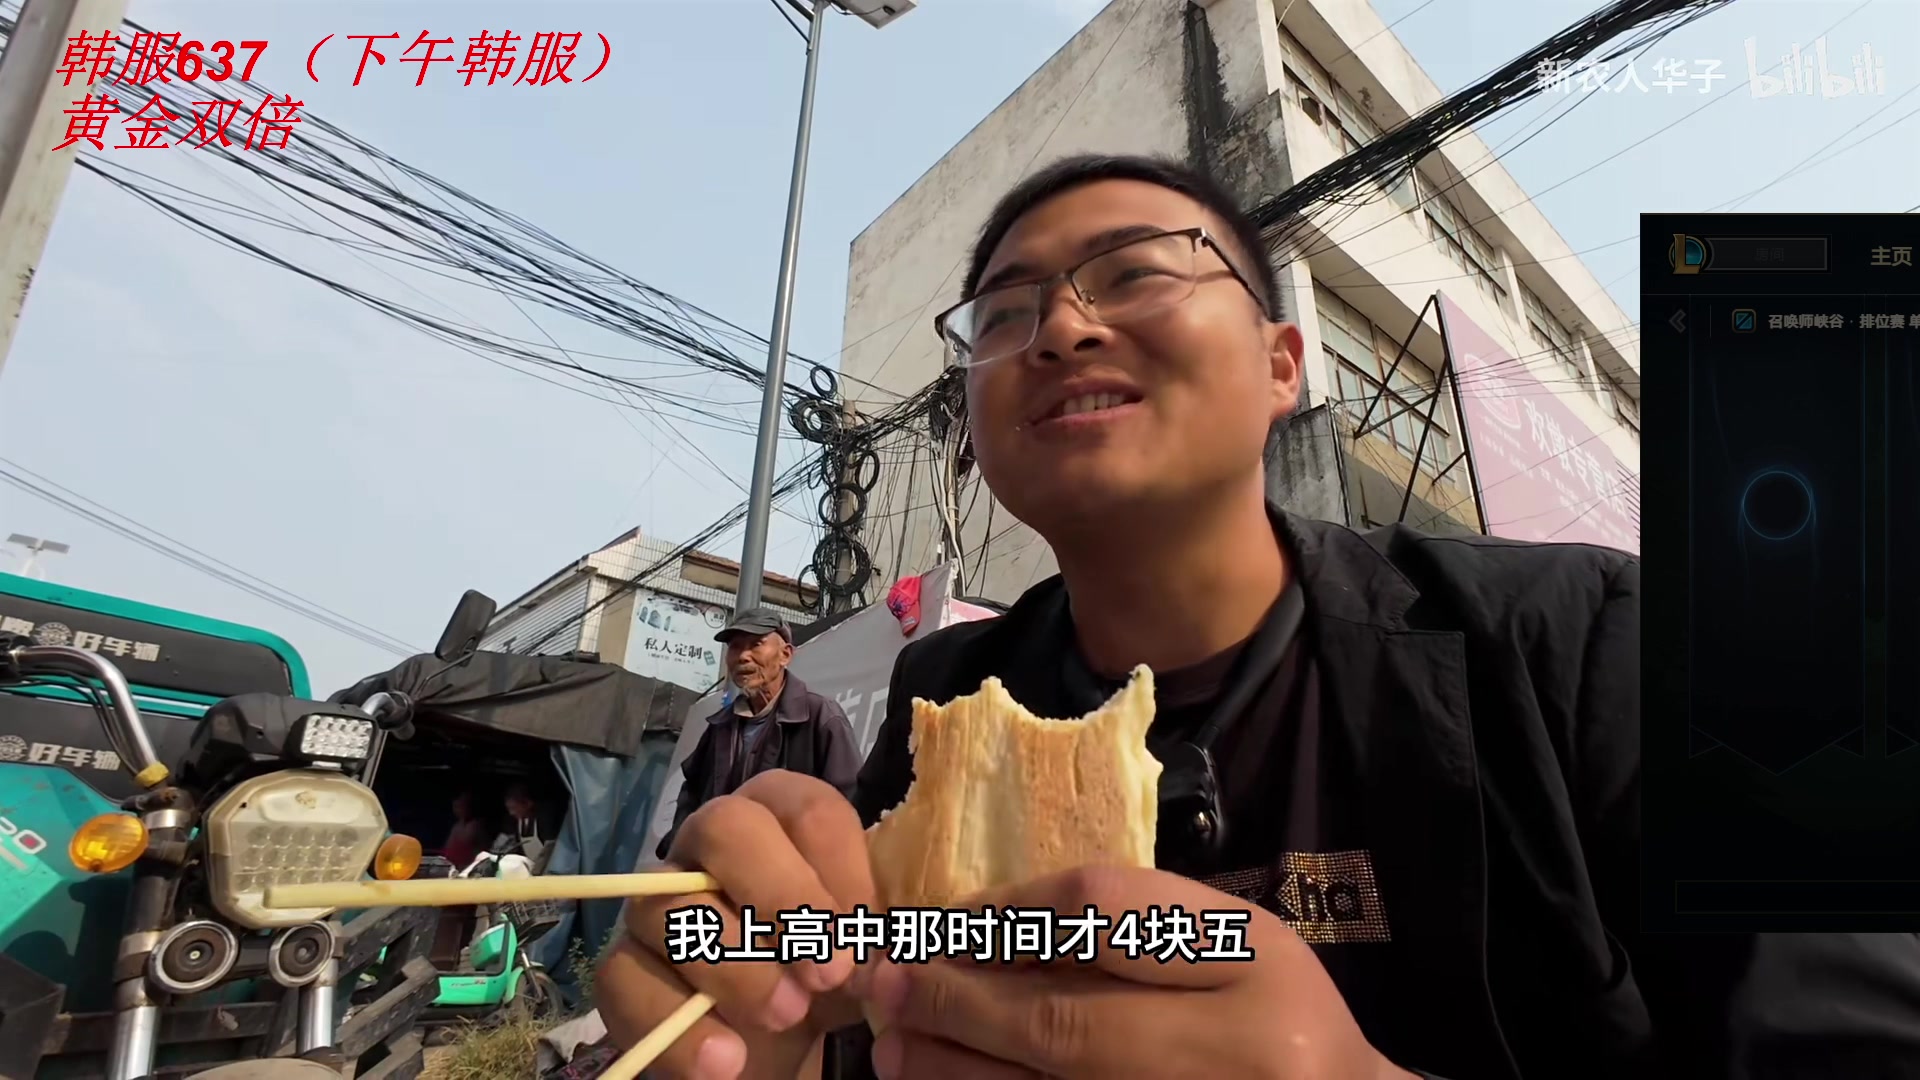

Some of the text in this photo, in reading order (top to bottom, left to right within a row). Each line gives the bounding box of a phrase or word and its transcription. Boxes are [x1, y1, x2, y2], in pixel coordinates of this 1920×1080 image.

[73, 630, 160, 662] 好车辆
[644, 637, 703, 660] 私人定制
[28, 742, 121, 771] 好车辆
